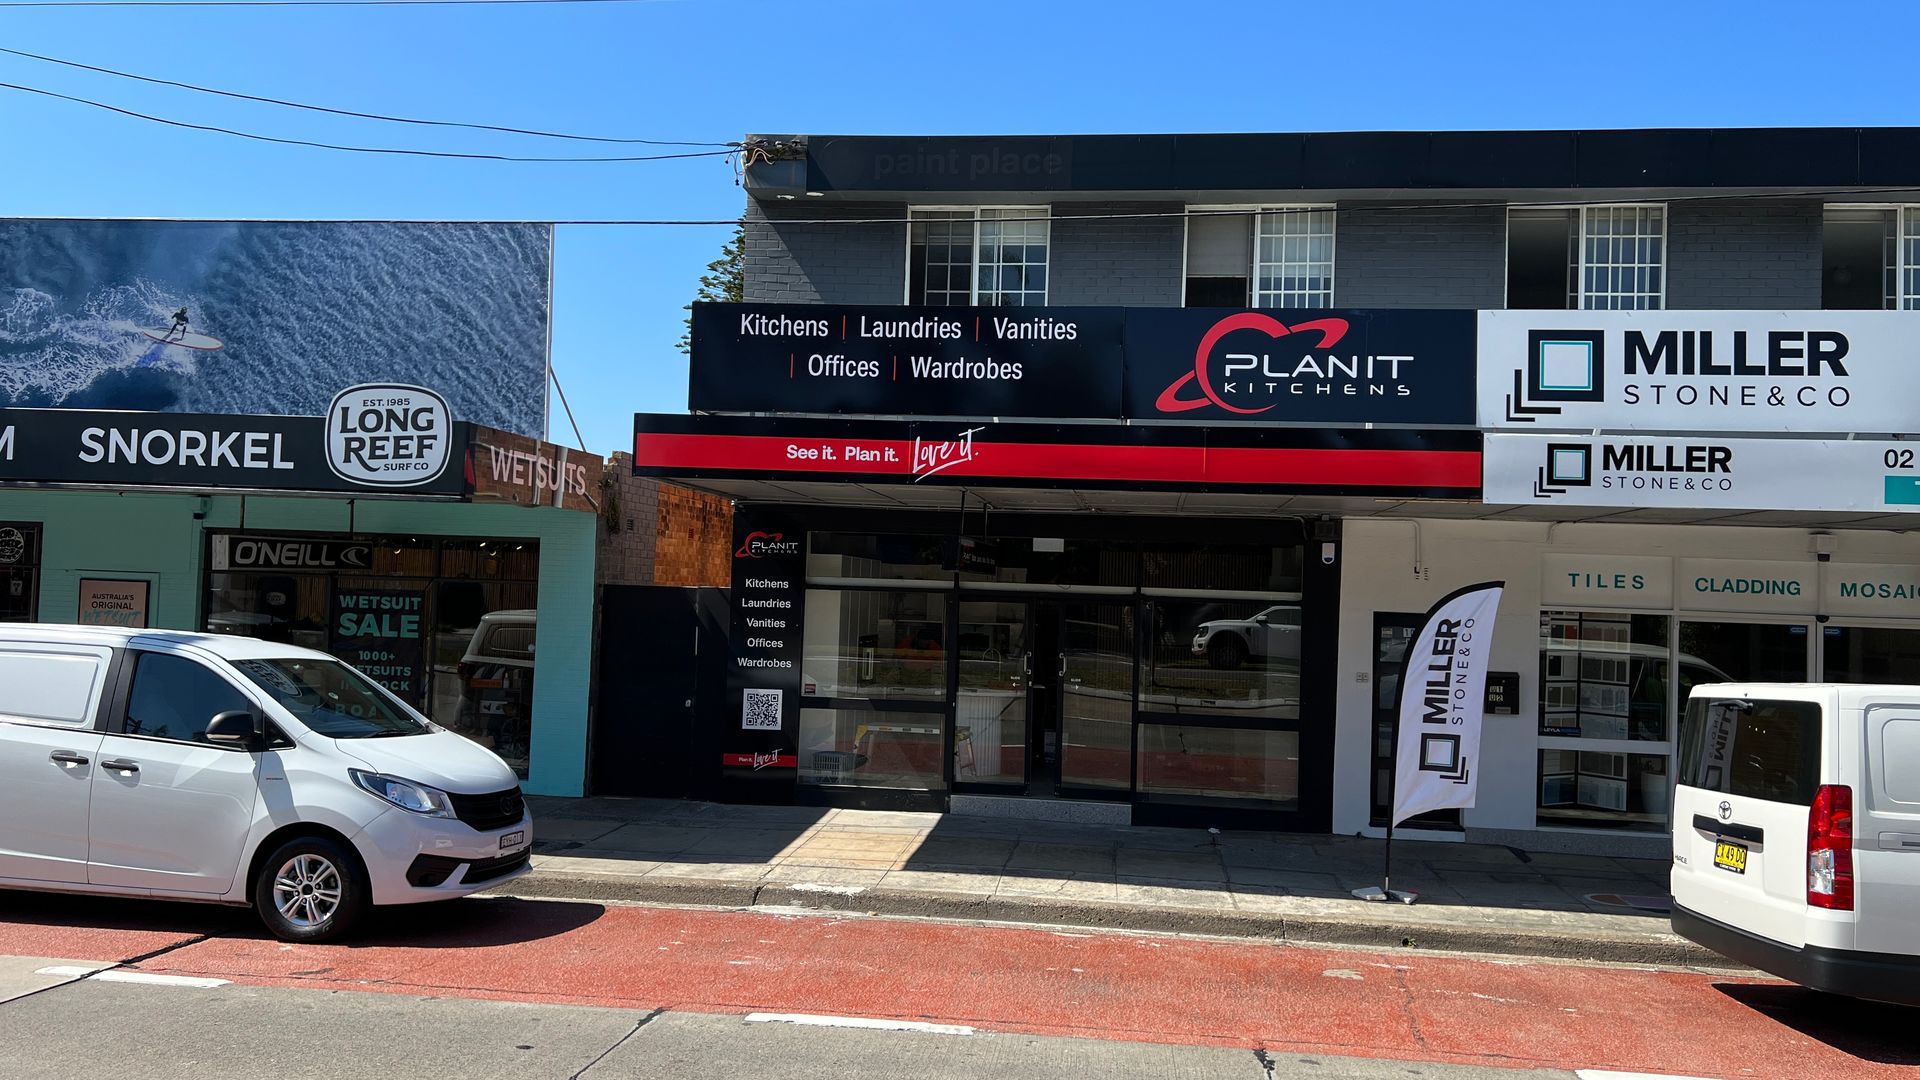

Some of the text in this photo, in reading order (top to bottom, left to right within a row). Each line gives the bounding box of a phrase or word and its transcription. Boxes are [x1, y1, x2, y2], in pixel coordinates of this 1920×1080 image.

[875, 147, 1064, 180] paint place
[741, 313, 1077, 341] Kitchens Laundries Vanities
[1624, 330, 1850, 377] MILLER
[808, 354, 1023, 380] Offices Wardrobes
[1225, 354, 1414, 380] PLANIT
[1224, 382, 1411, 396] KITCHENS
[1623, 384, 1851, 407] STONE&CO
[363, 398, 411, 407] EST. 1985
[340, 406, 434, 433] LONG
[78, 426, 295, 470] SNORKEL
[342, 435, 438, 472] REEF
[786, 444, 818, 460] See
[821, 444, 837, 460] it.
[845, 445, 879, 462] Plan
[883, 446, 899, 462] it.
[912, 436, 960, 474] Love
[383, 462, 429, 471] SURF CO
[1602, 444, 1732, 473] MILLER
[1883, 449, 1914, 469] 02
[490, 445, 587, 496] WETSUITS
[1602, 475, 1732, 491] STONE&CO
[235, 541, 336, 567] O'NEILL
[752, 541, 798, 550] PLANIT
[745, 578, 789, 589] Kitchens
[1568, 573, 1645, 590] TILES
[1694, 577, 1801, 596] CLADDING
[1840, 581, 1920, 599] MOSAI
[91, 592, 134, 601] AUSTRALIA'S
[91, 601, 134, 610] ORIGINAL
[339, 595, 422, 610] WETSUIT
[741, 598, 791, 609] Laundries
[338, 613, 420, 638] SALE
[746, 618, 786, 628] Vanities
[746, 637, 784, 648] Offices
[358, 650, 396, 661] 1000+
[737, 657, 792, 668] Wardrobes
[350, 664, 412, 677] ETSUITS
[1422, 617, 1462, 724] MILLER
[1451, 617, 1476, 726] STONE&CO
[375, 680, 410, 691] OCK
